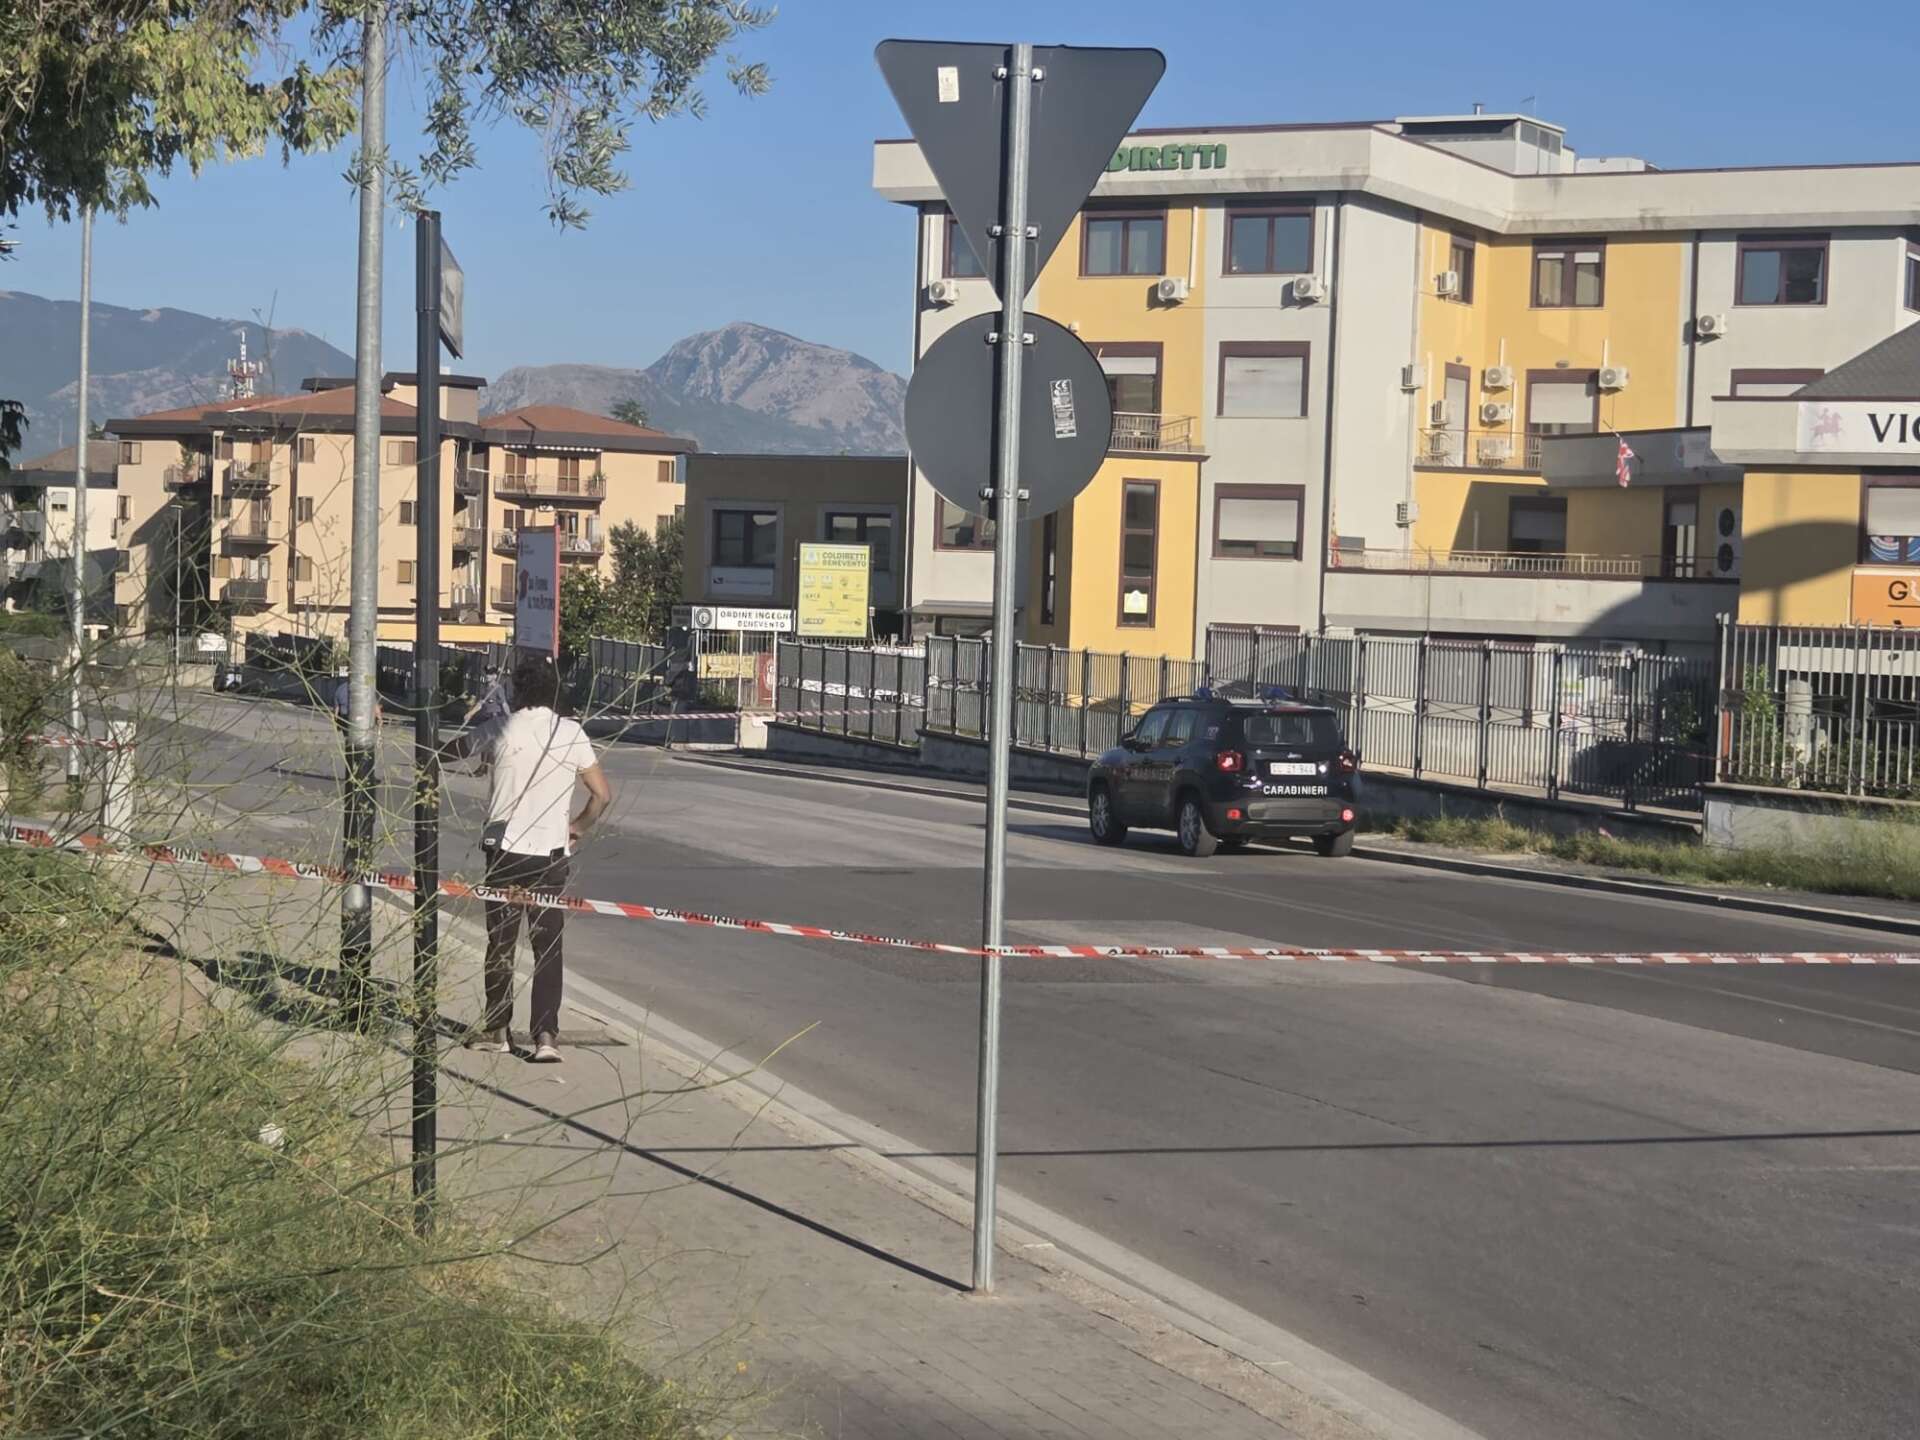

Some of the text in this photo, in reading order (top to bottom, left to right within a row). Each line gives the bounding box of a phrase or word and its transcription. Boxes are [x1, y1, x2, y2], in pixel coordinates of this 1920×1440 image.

[1105, 143, 1227, 172] DIRETTI
[822, 552, 867, 560] COLDIRETTI
[822, 559, 867, 568] BENEVENTO
[720, 611, 792, 620] ORDINE INGEGN
[737, 620, 786, 628] BENEVENTO
[1263, 785, 1328, 795] CARABINIERI
[296, 863, 407, 886] CARANIERI
[474, 885, 584, 907] CARINIERI
